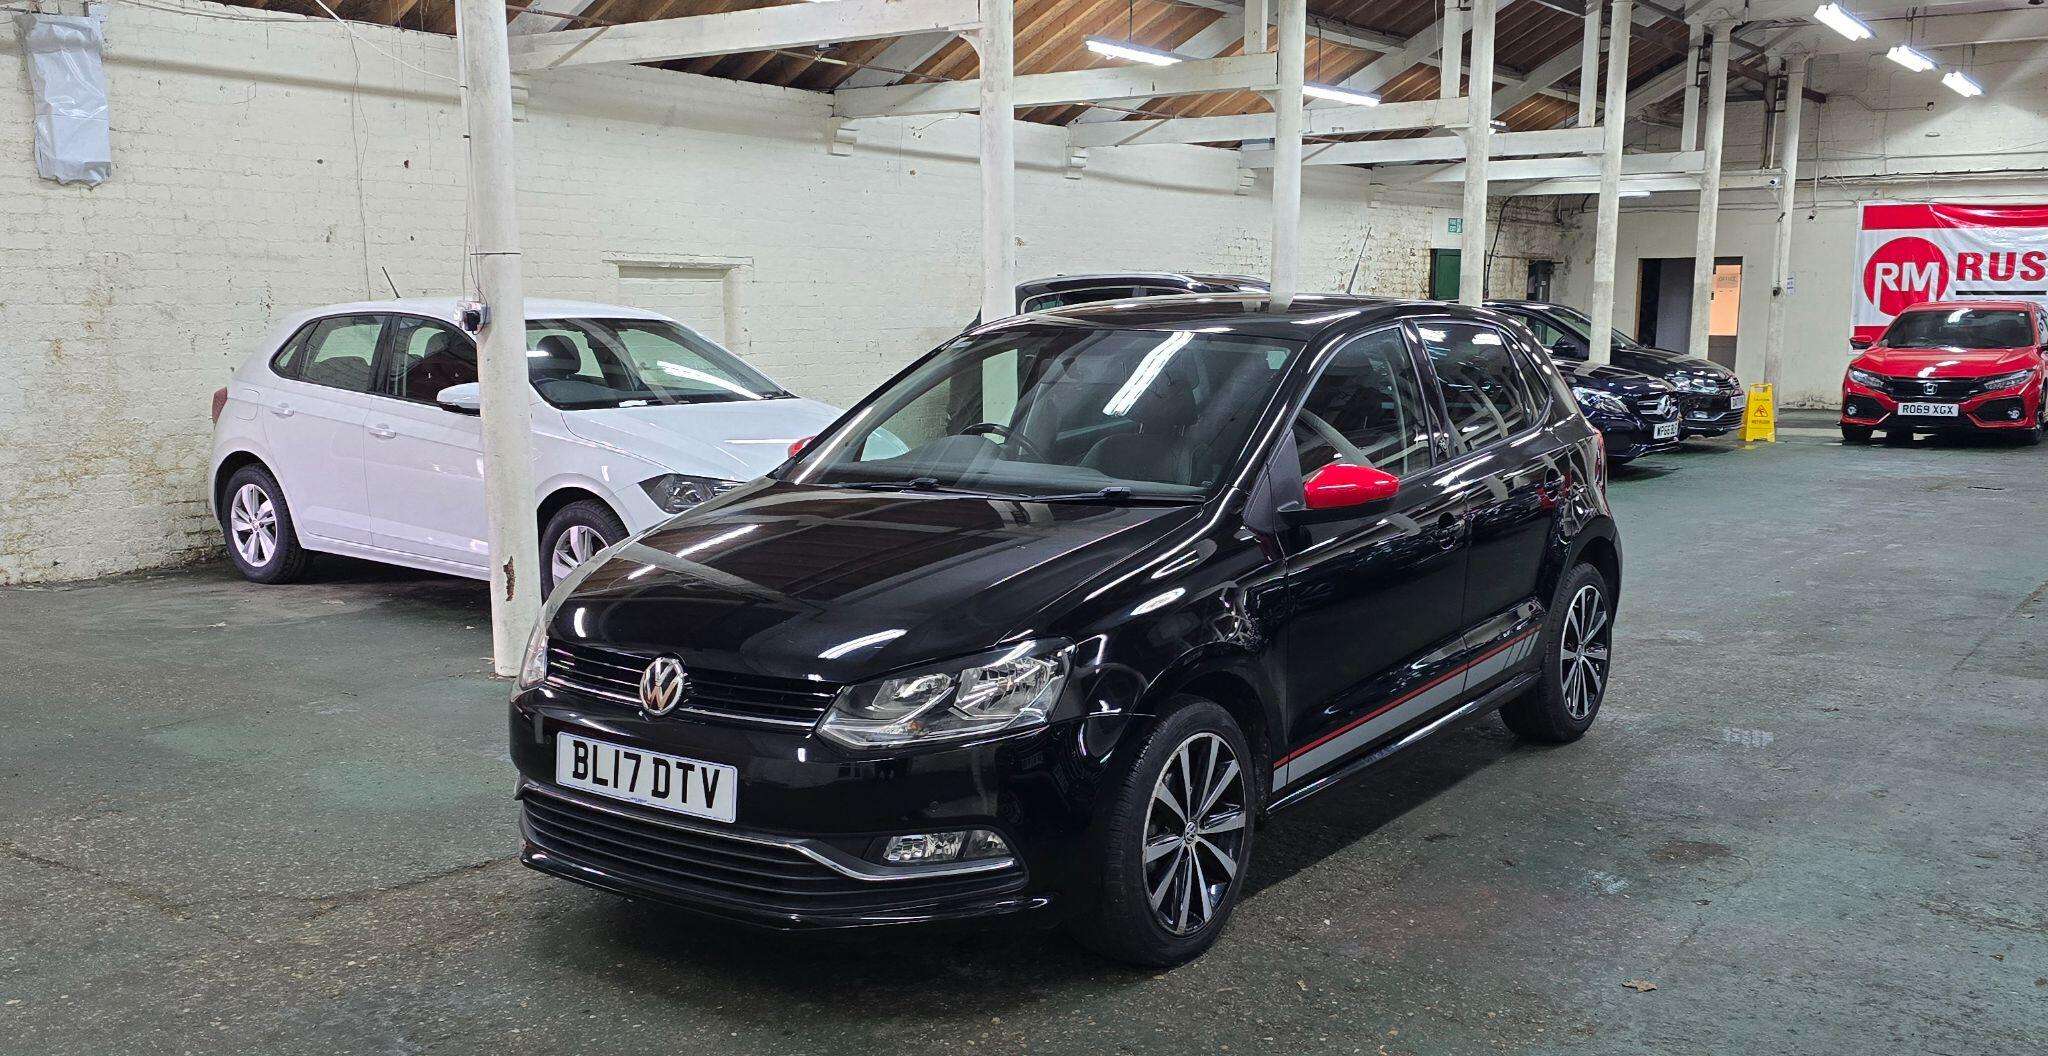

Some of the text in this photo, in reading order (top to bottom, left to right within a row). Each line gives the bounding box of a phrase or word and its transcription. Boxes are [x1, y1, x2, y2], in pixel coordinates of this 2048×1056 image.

[1874, 261, 1941, 311] RM
[1956, 251, 2047, 282] RUS
[1902, 404, 1954, 415] RO69 XGX
[572, 739, 721, 809] BL17 DTV
